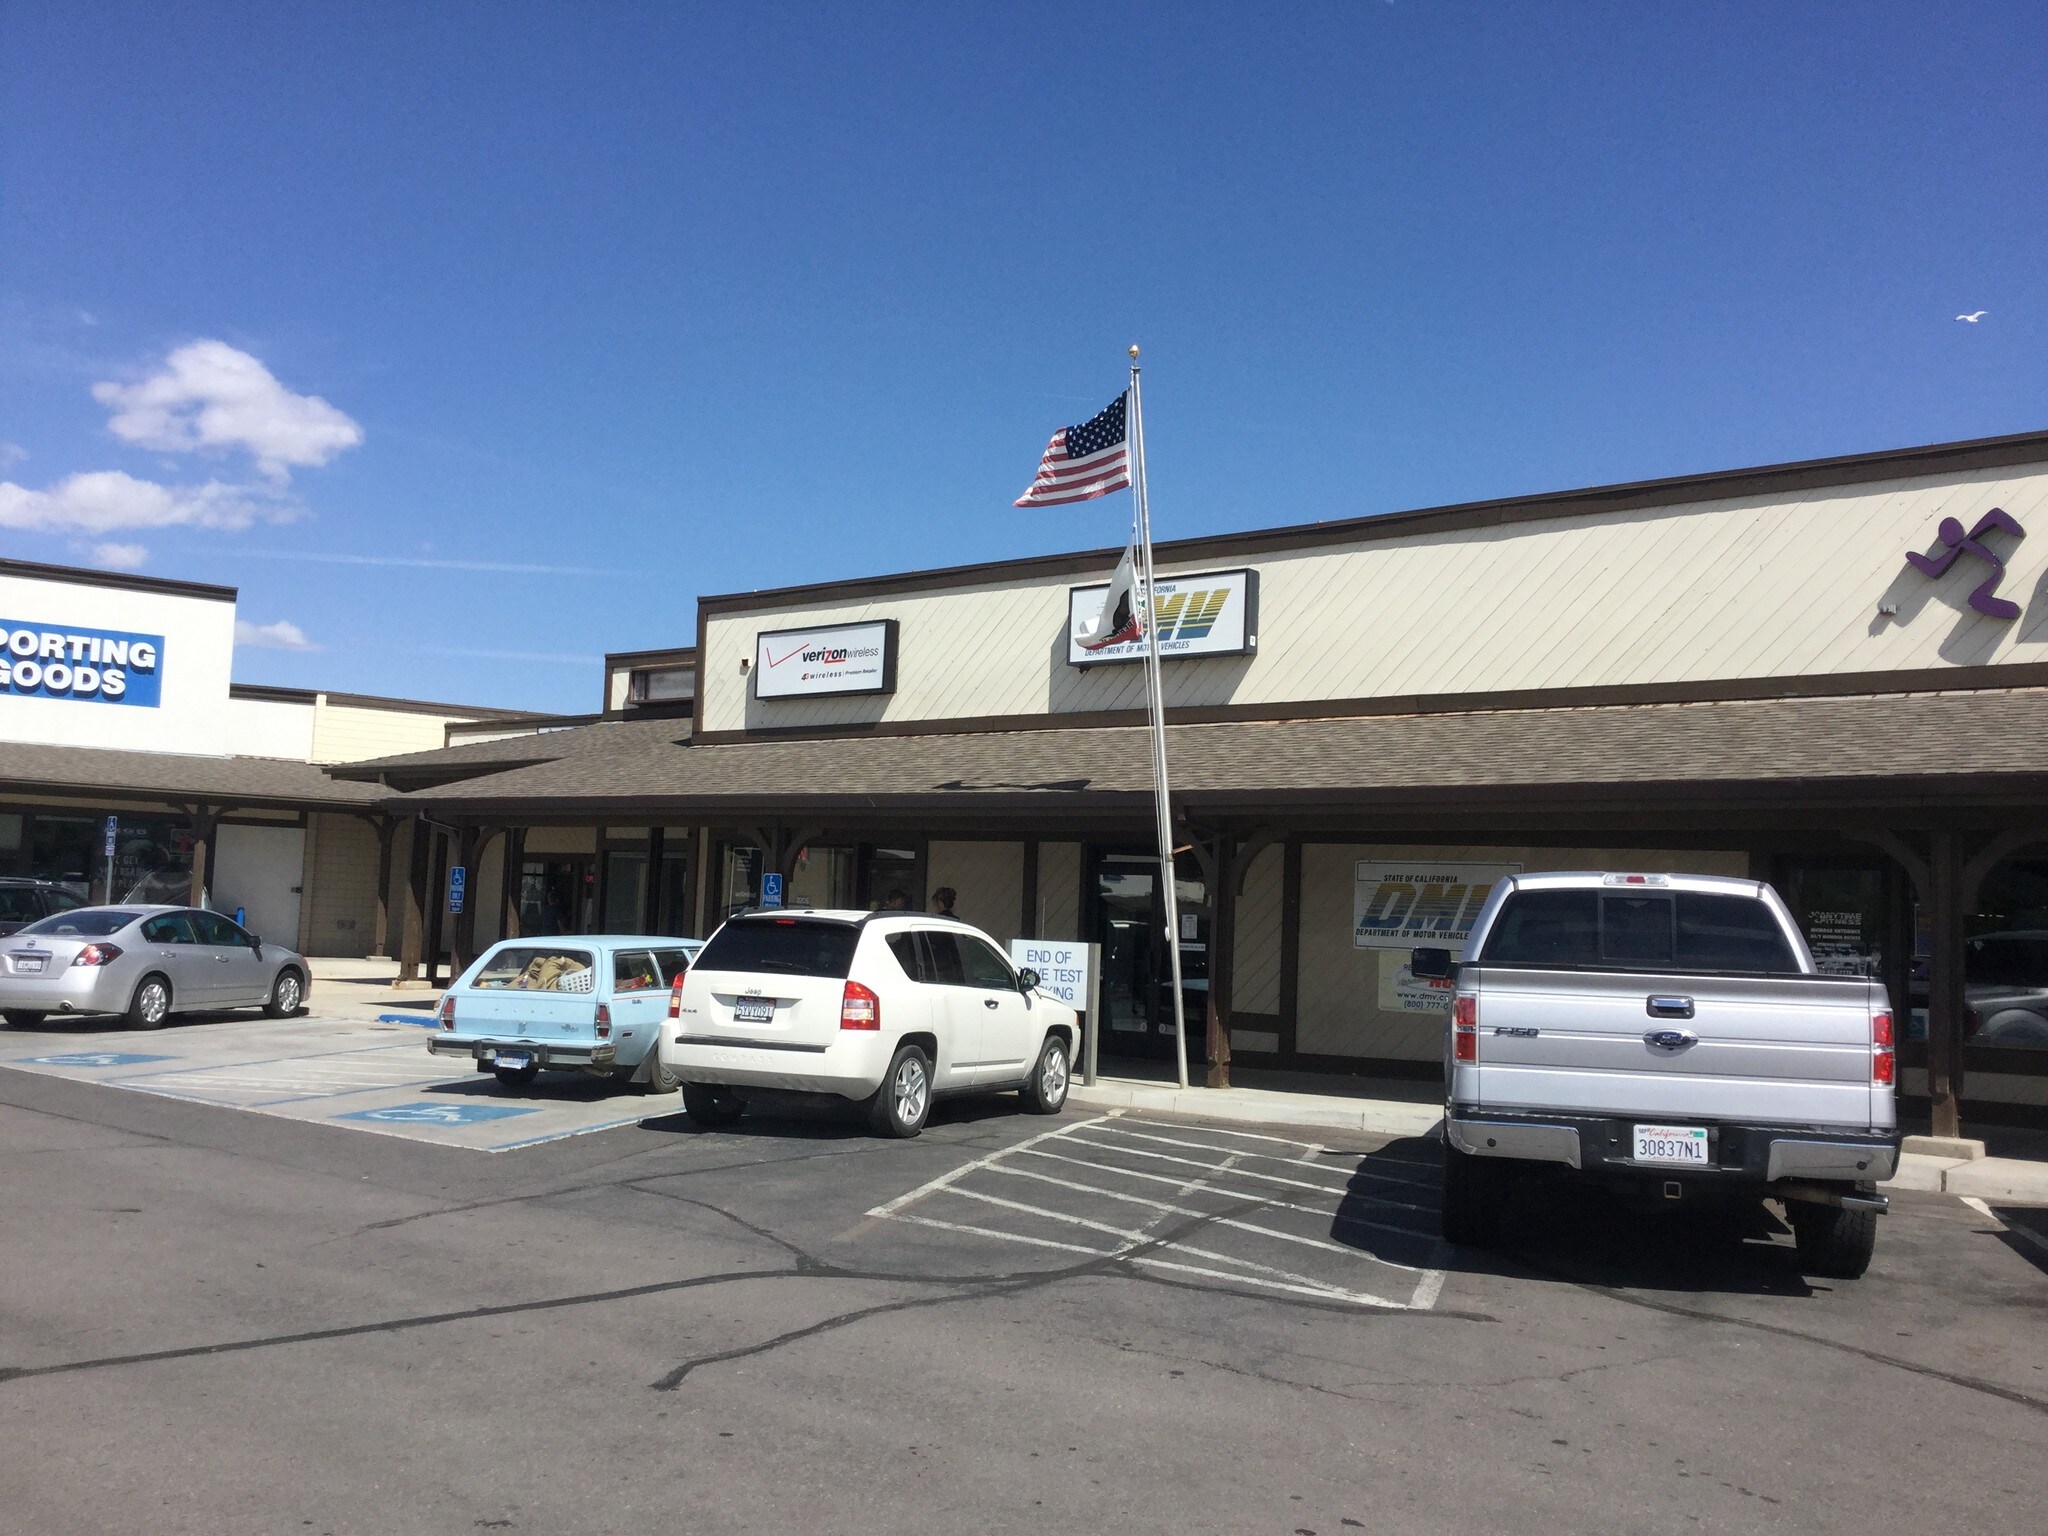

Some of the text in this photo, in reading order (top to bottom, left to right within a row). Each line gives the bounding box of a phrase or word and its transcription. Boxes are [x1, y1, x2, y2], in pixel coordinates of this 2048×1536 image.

[1085, 646, 1125, 656] DEPARTMENT
[1126, 645, 1135, 654] OF
[1160, 641, 1190, 650] VEHICLES
[802, 647, 879, 663] verizon wireless
[810, 671, 842, 679] wireless
[1383, 874, 1458, 883] STATE OF CALIFORNIA
[1355, 928, 1469, 940] DEPARTMENT OF MOTOR VEHICLE
[1027, 949, 1072, 964] END OF
[1053, 968, 1083, 983] TEST
[745, 987, 761, 996] Jeep
[1404, 1001, 1448, 1010] (800) 777-0
[1648, 1128, 1690, 1139] California
[1639, 1138, 1703, 1158] 30837N1
